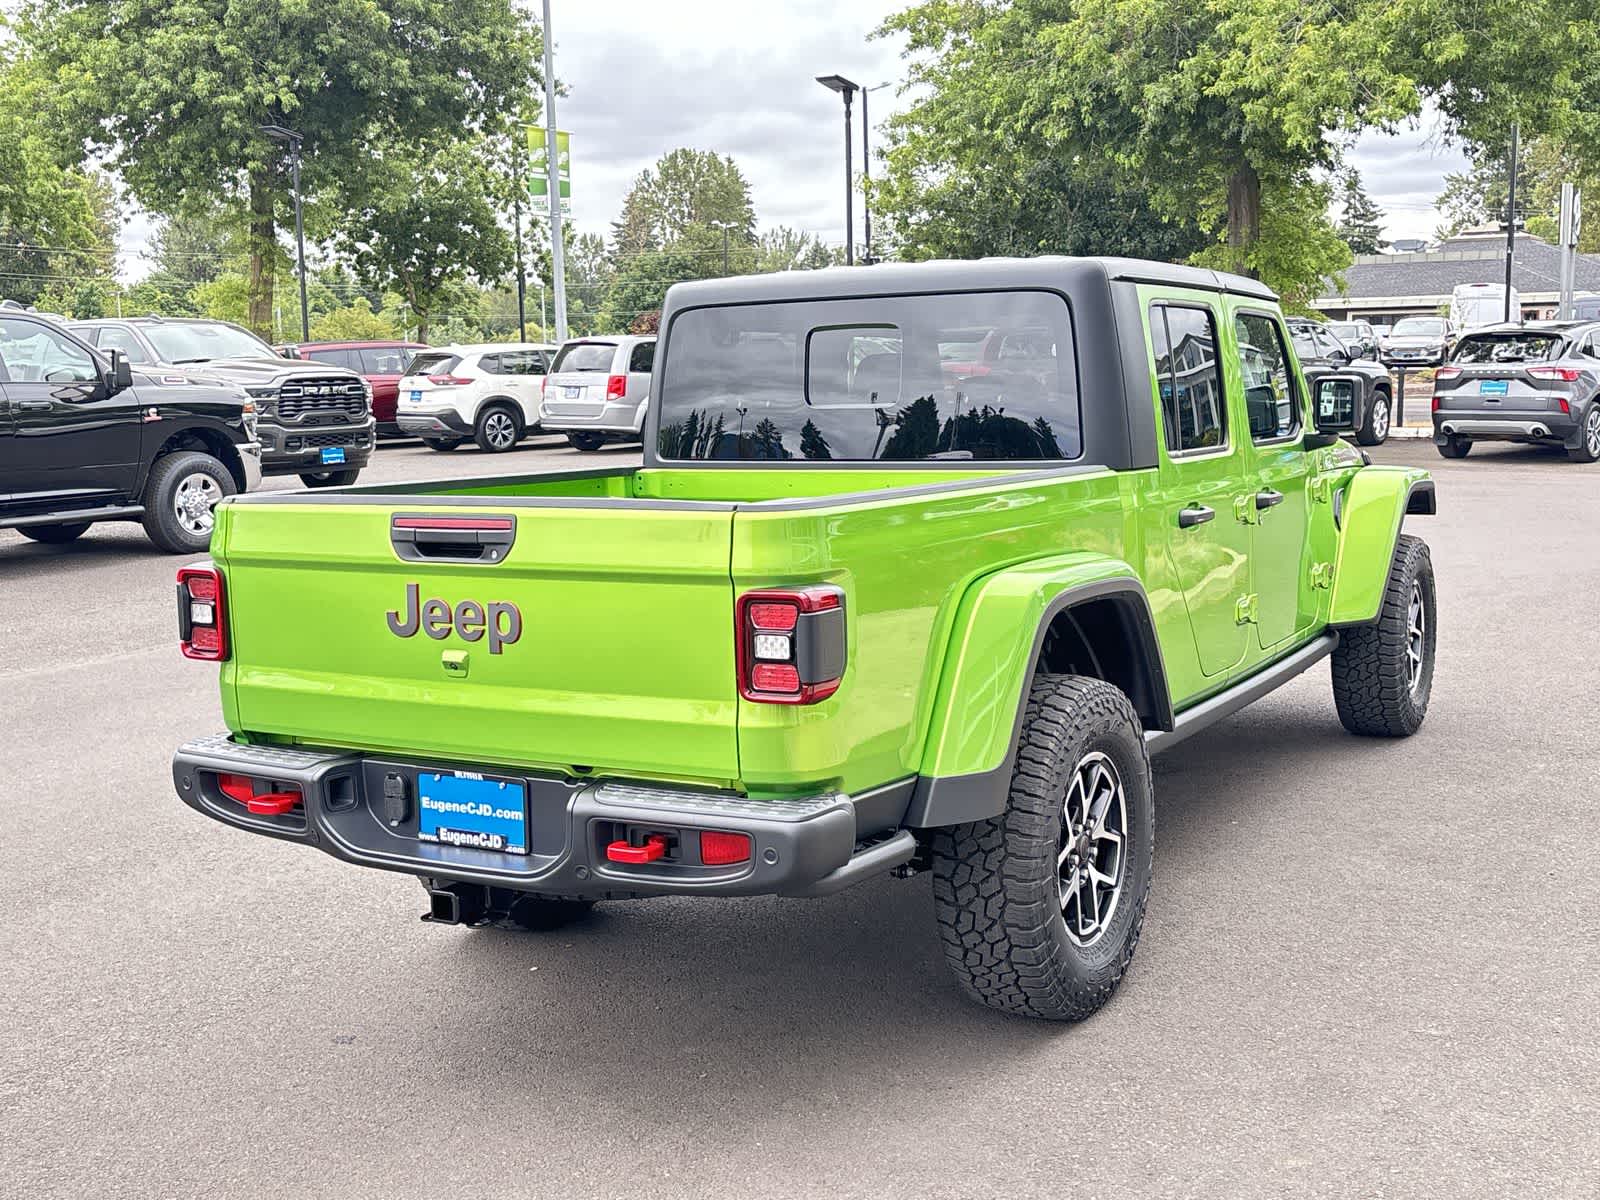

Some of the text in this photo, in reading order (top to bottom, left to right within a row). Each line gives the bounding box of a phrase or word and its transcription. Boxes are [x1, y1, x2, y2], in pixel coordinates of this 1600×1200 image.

[386, 583, 523, 655] Jeep
[421, 796, 523, 820] EugeneCJD.com
[439, 827, 502, 848] EugeneCJD
